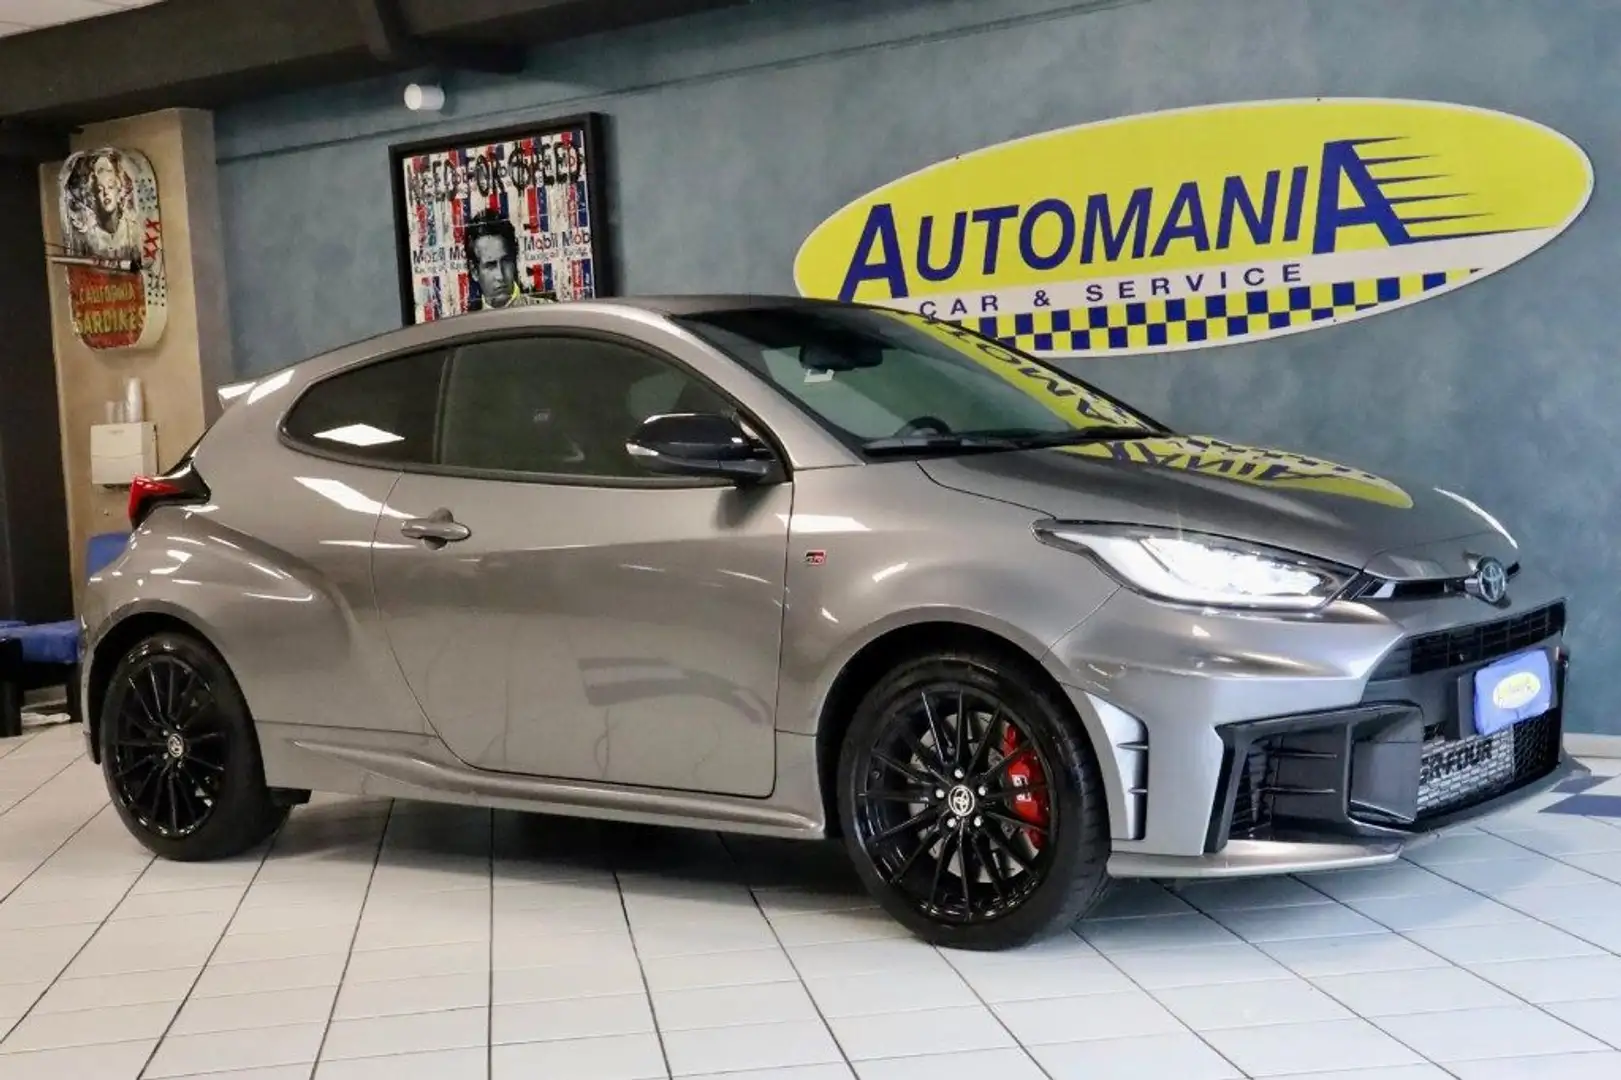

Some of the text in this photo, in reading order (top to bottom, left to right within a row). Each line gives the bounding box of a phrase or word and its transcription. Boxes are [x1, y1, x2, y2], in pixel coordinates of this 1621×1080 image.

[838, 138, 1412, 303] AUTOMANIA
[919, 263, 1304, 320] CAR & SERVICE
